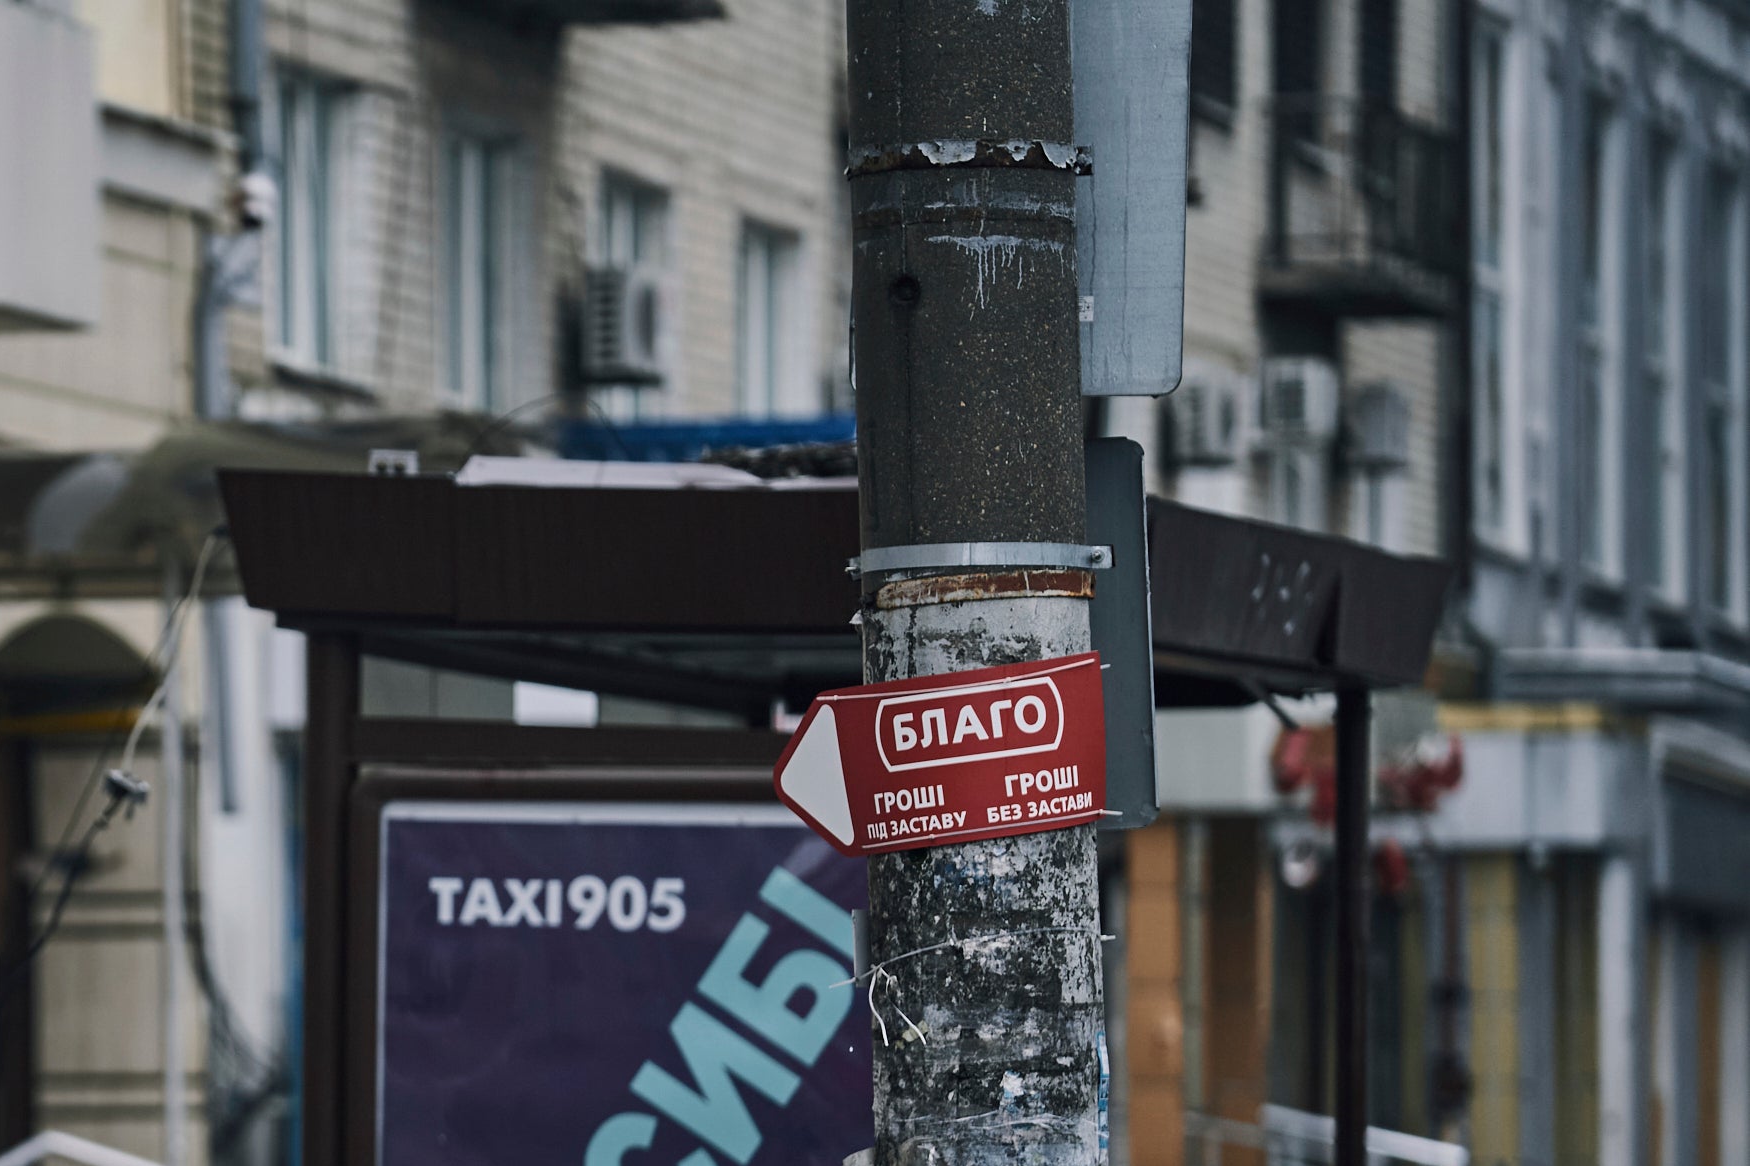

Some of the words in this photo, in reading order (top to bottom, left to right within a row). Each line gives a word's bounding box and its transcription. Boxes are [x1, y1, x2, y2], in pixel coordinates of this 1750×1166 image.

[892, 694, 1048, 752] БЛАГО
[1004, 765, 1079, 798] ГРОШІ
[873, 784, 945, 815] ГРОШІ
[986, 803, 1022, 824] БЕЗ
[1027, 791, 1093, 819] ЗАСТАВИ
[866, 822, 889, 841] ПІД
[890, 810, 967, 836] ЗАСТАВУ
[429, 875, 686, 932] TAXI905
